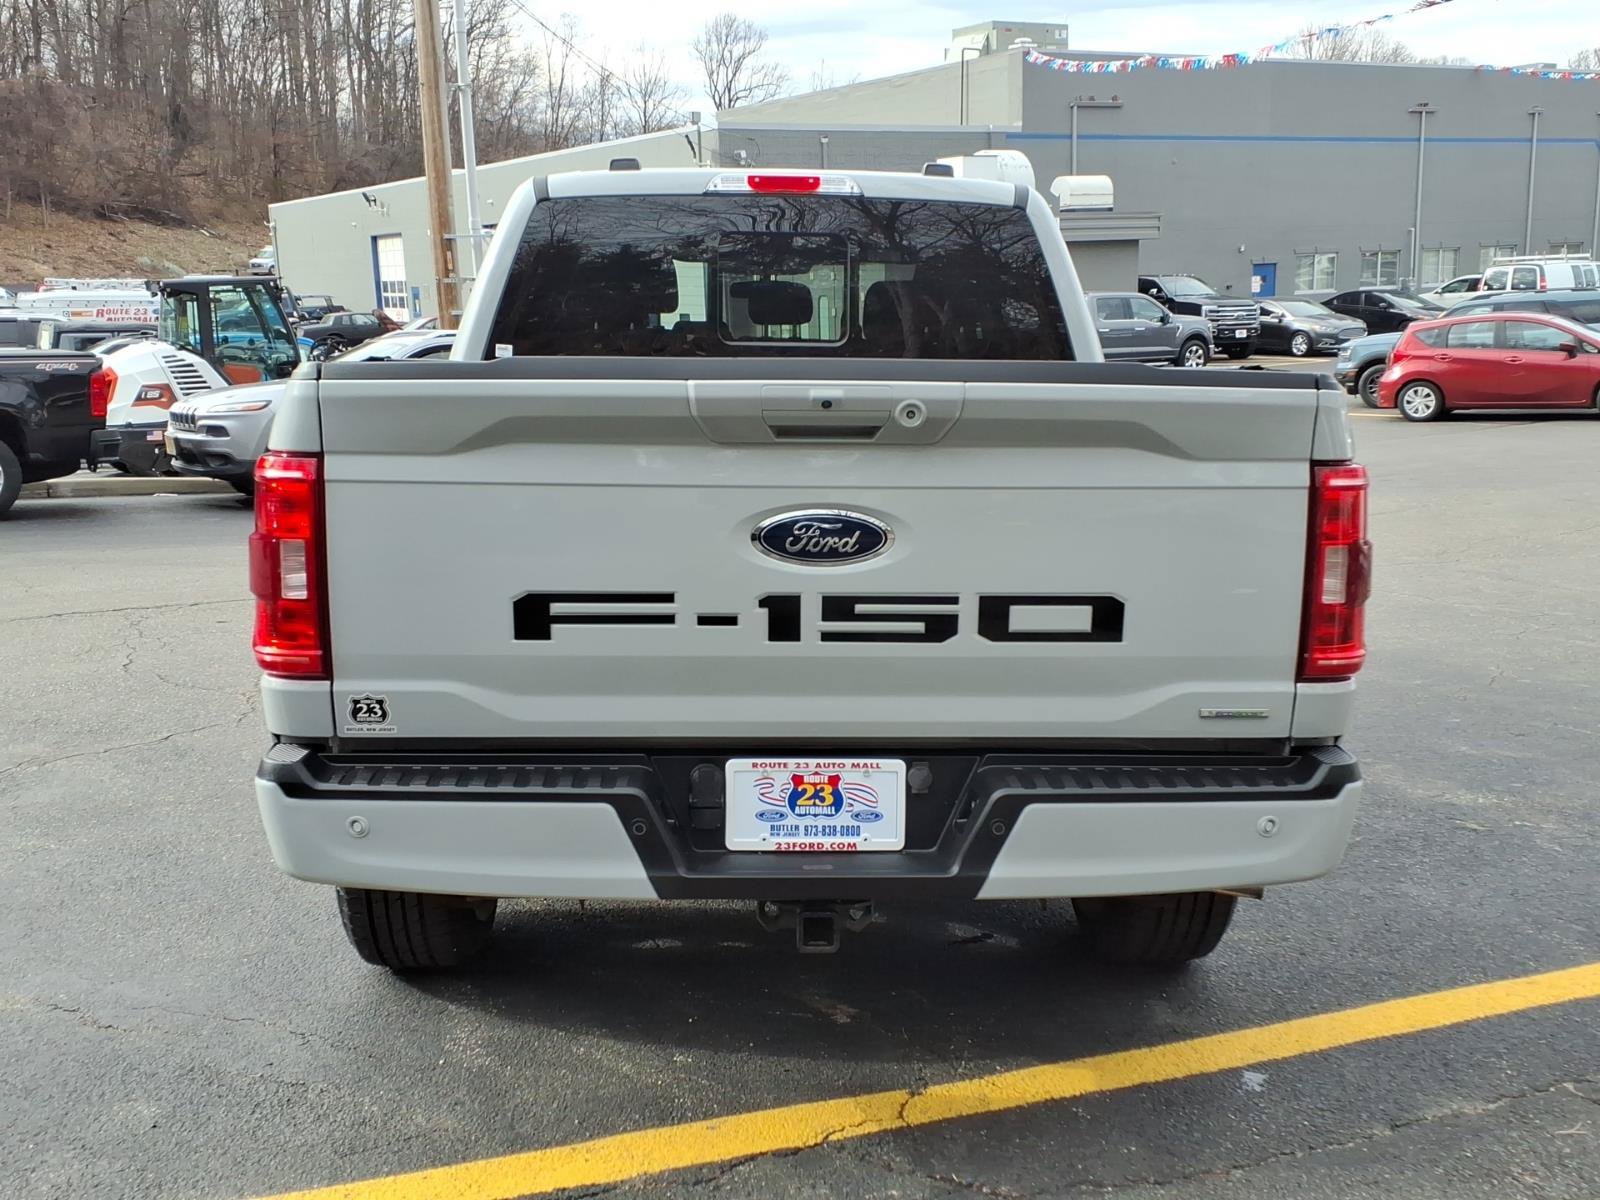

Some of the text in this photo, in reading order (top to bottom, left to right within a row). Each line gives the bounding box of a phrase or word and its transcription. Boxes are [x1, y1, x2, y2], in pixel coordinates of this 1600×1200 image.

[96, 308, 131, 318] ROUTE
[133, 307, 148, 315] 23
[785, 521, 861, 552] Ford
[513, 592, 1125, 643] F-150
[356, 703, 382, 717] 23
[803, 774, 829, 784] ROUTE
[796, 783, 834, 806] 23
[794, 806, 836, 815] AUTOMALL
[770, 824, 861, 837] BUTLER 973-838-0800
[774, 842, 858, 850] 23FORD.COM
